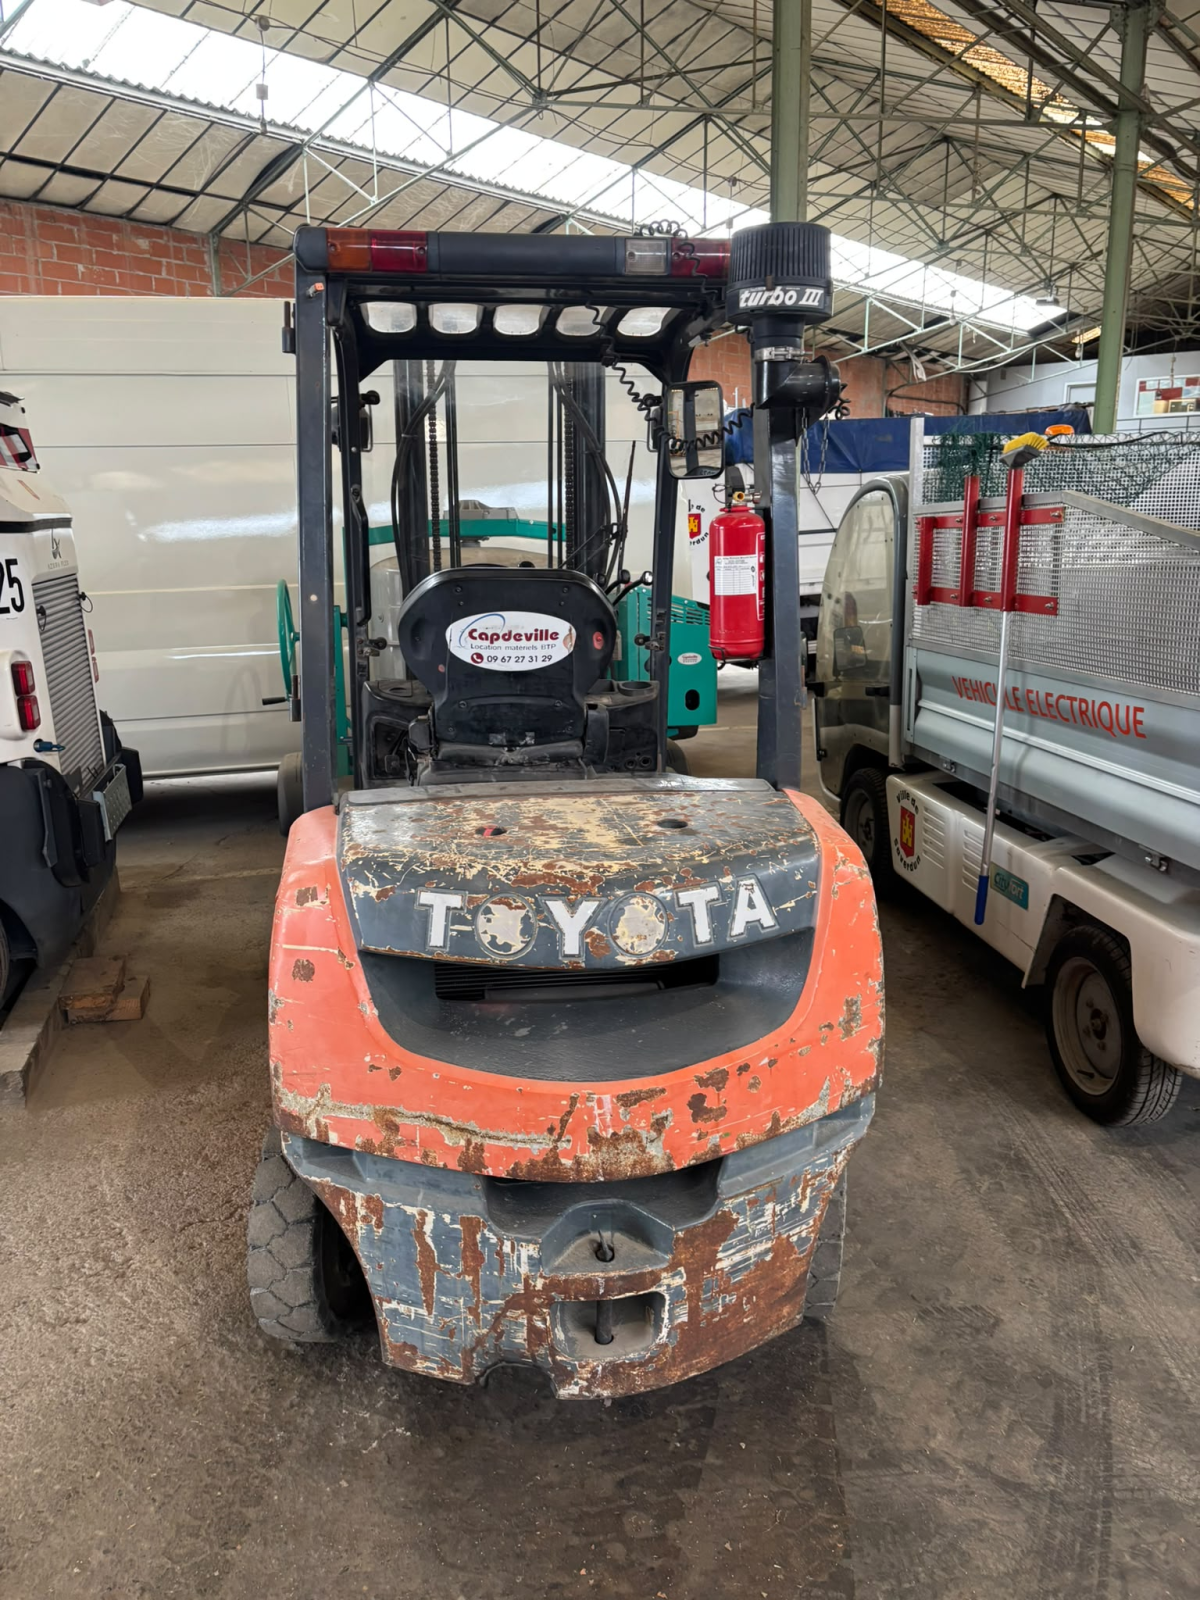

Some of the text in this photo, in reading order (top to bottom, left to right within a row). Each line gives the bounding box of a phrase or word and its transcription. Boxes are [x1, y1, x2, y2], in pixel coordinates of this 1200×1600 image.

[739, 286, 824, 308] turbo III
[468, 628, 560, 645] Capdeville
[470, 643, 502, 651] Location
[541, 643, 556, 651] BTP
[487, 654, 553, 664] 09 67 27 31 29
[1025, 688, 1147, 739] ELECTRIQUE
[896, 789, 910, 804] Ville
[415, 875, 778, 959] TOYOTA
